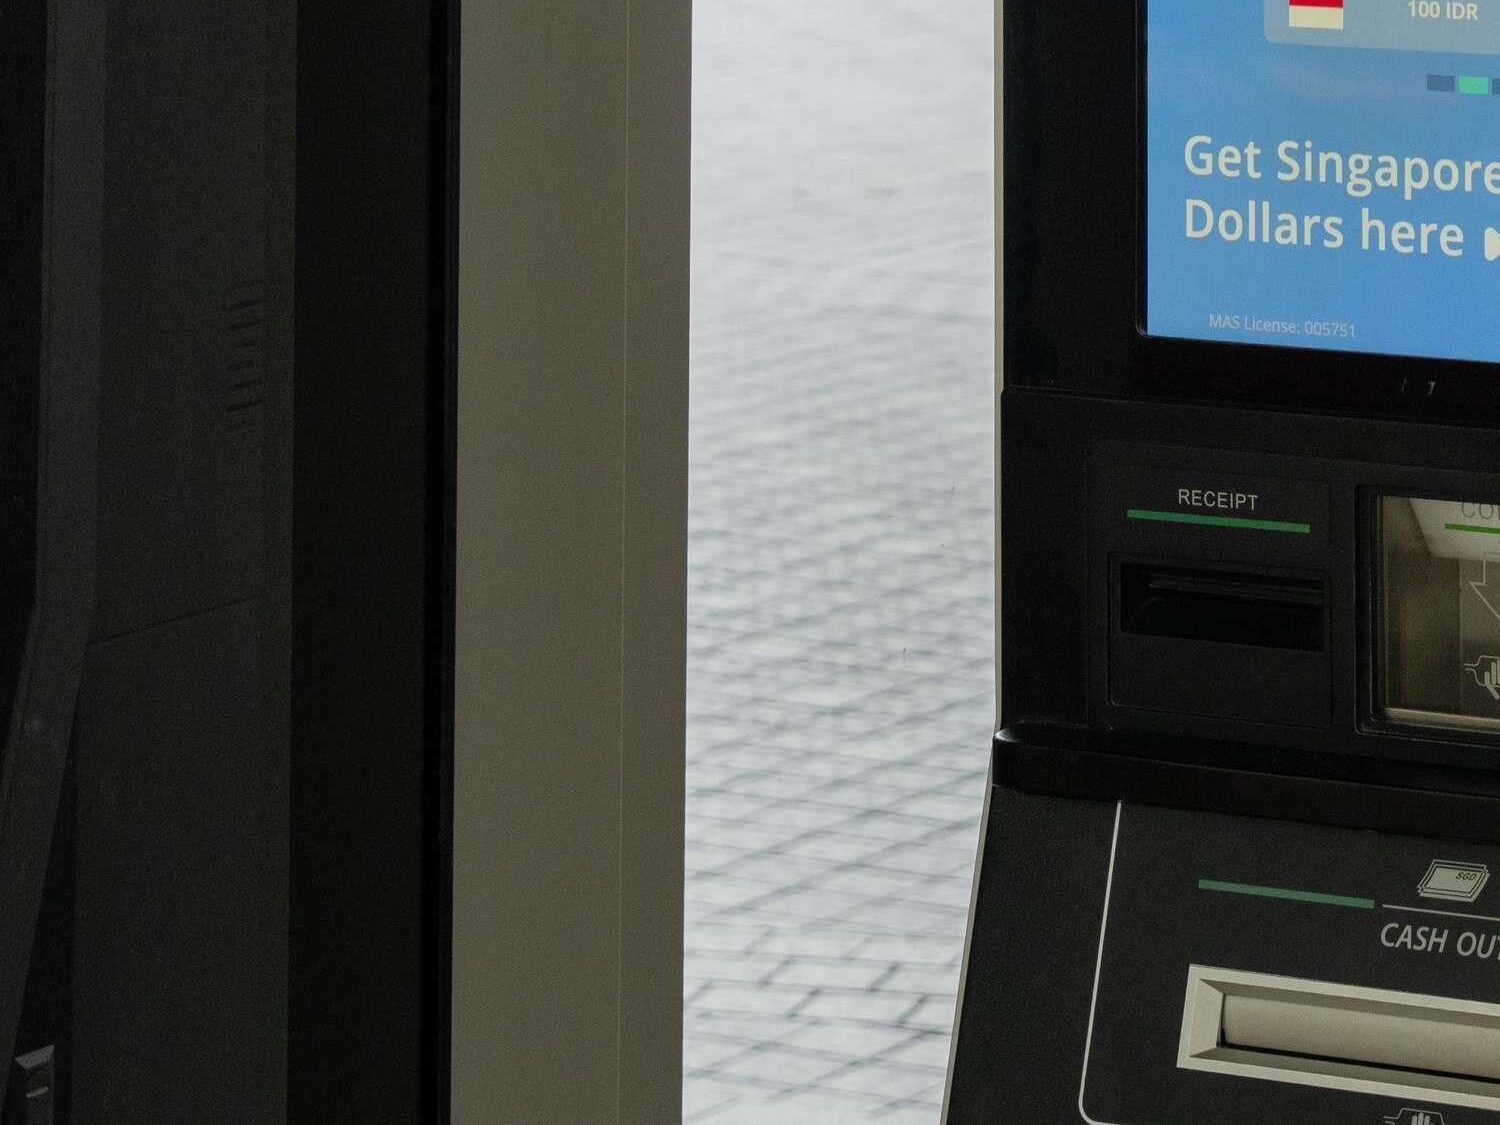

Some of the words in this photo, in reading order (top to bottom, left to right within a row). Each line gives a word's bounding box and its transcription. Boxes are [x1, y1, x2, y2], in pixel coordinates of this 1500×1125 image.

[1408, 0, 1441, 19] 100
[1446, 2, 1478, 20] IDR
[1184, 135, 1261, 179] Get
[1185, 198, 1344, 248] Dollars
[1361, 207, 1464, 257] here
[1209, 314, 1240, 329] MAS
[1244, 316, 1300, 334] License:
[1304, 320, 1355, 338] 005751
[1178, 488, 1258, 510] RECEIPT
[1380, 922, 1449, 953] CASH
